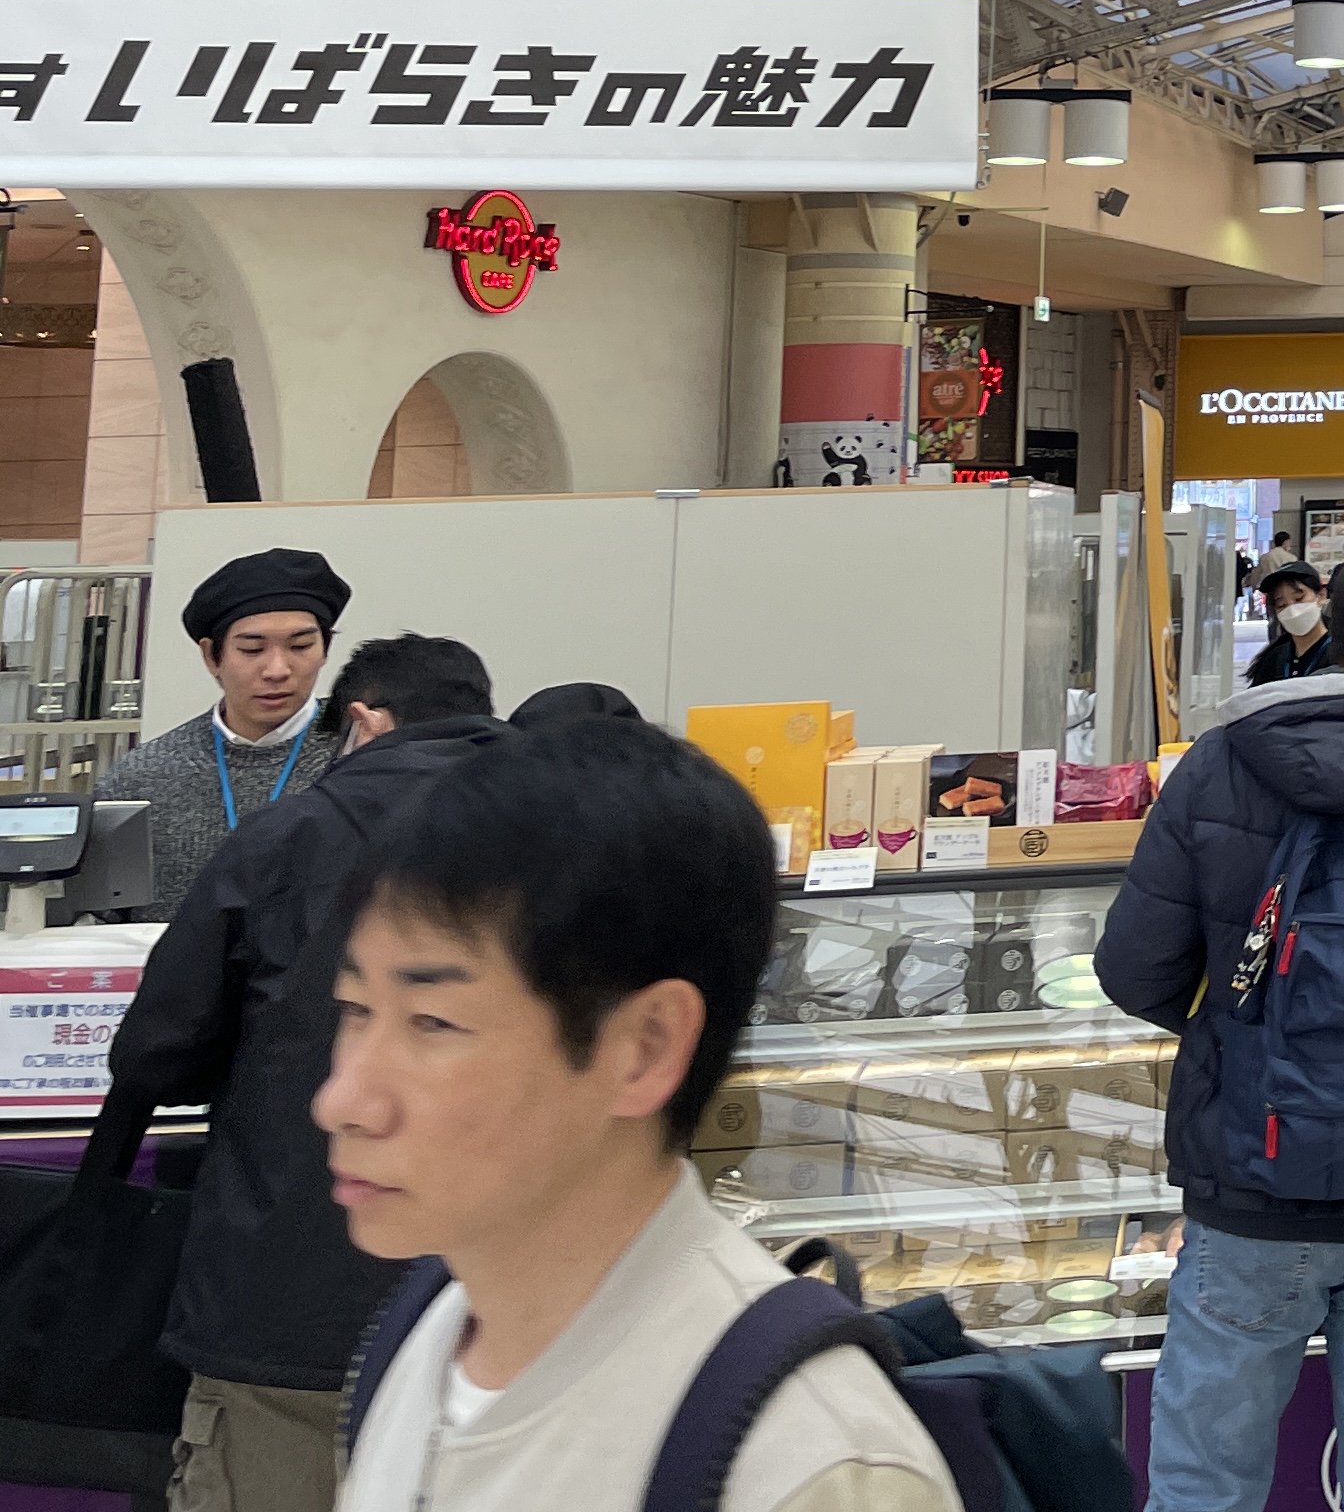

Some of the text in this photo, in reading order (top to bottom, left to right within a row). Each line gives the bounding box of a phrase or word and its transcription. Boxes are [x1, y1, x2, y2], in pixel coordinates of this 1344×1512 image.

[1226, 413, 1325, 425] EN PROVENCE
[52, 1023, 120, 1045] 現金の
